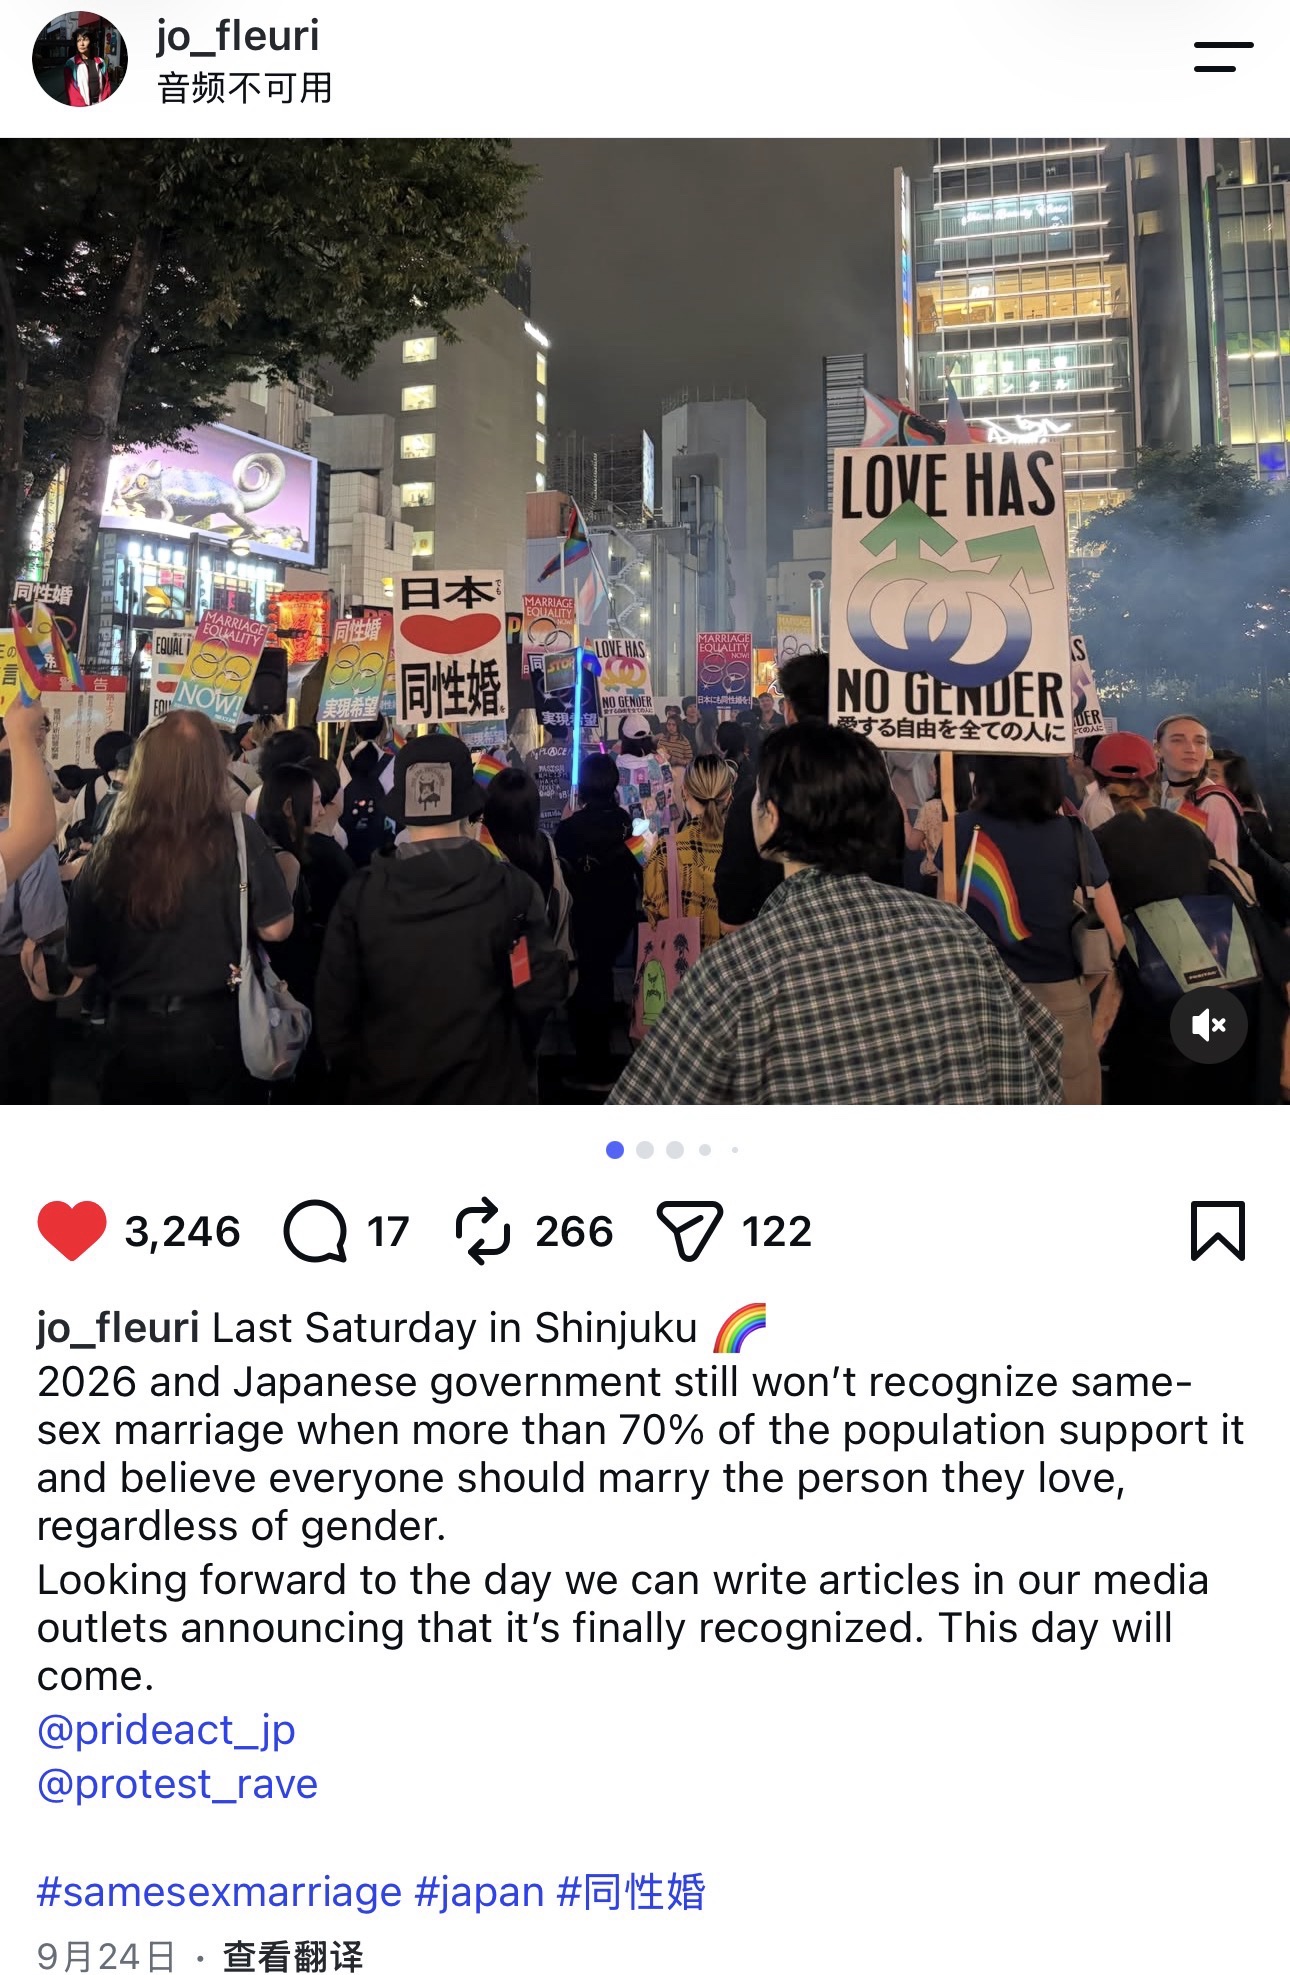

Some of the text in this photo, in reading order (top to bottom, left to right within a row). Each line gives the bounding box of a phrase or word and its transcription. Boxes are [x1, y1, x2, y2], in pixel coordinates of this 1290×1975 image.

[841, 449, 1056, 519] LOVE HAS
[13, 581, 73, 606] 同性婚
[401, 575, 496, 610] 日本
[525, 597, 574, 608] MARRIAGE
[205, 611, 267, 636] MARRIAGE
[526, 607, 572, 618] EQUALITY
[203, 622, 261, 647] EQUALITY
[333, 618, 381, 643] 同性婚
[698, 634, 750, 643] MARRIAGE
[155, 636, 184, 656] EQUAL
[595, 641, 645, 659] LOVE HAS
[699, 643, 749, 653] EQUALITY
[178, 682, 243, 717] NOW!
[401, 658, 501, 720] 同性婚
[838, 669, 1064, 718] NO GENDER
[322, 696, 379, 718] 実現希望
[602, 696, 653, 709] NO GENDER
[837, 716, 1066, 743] 愛する自由を全ての人に
